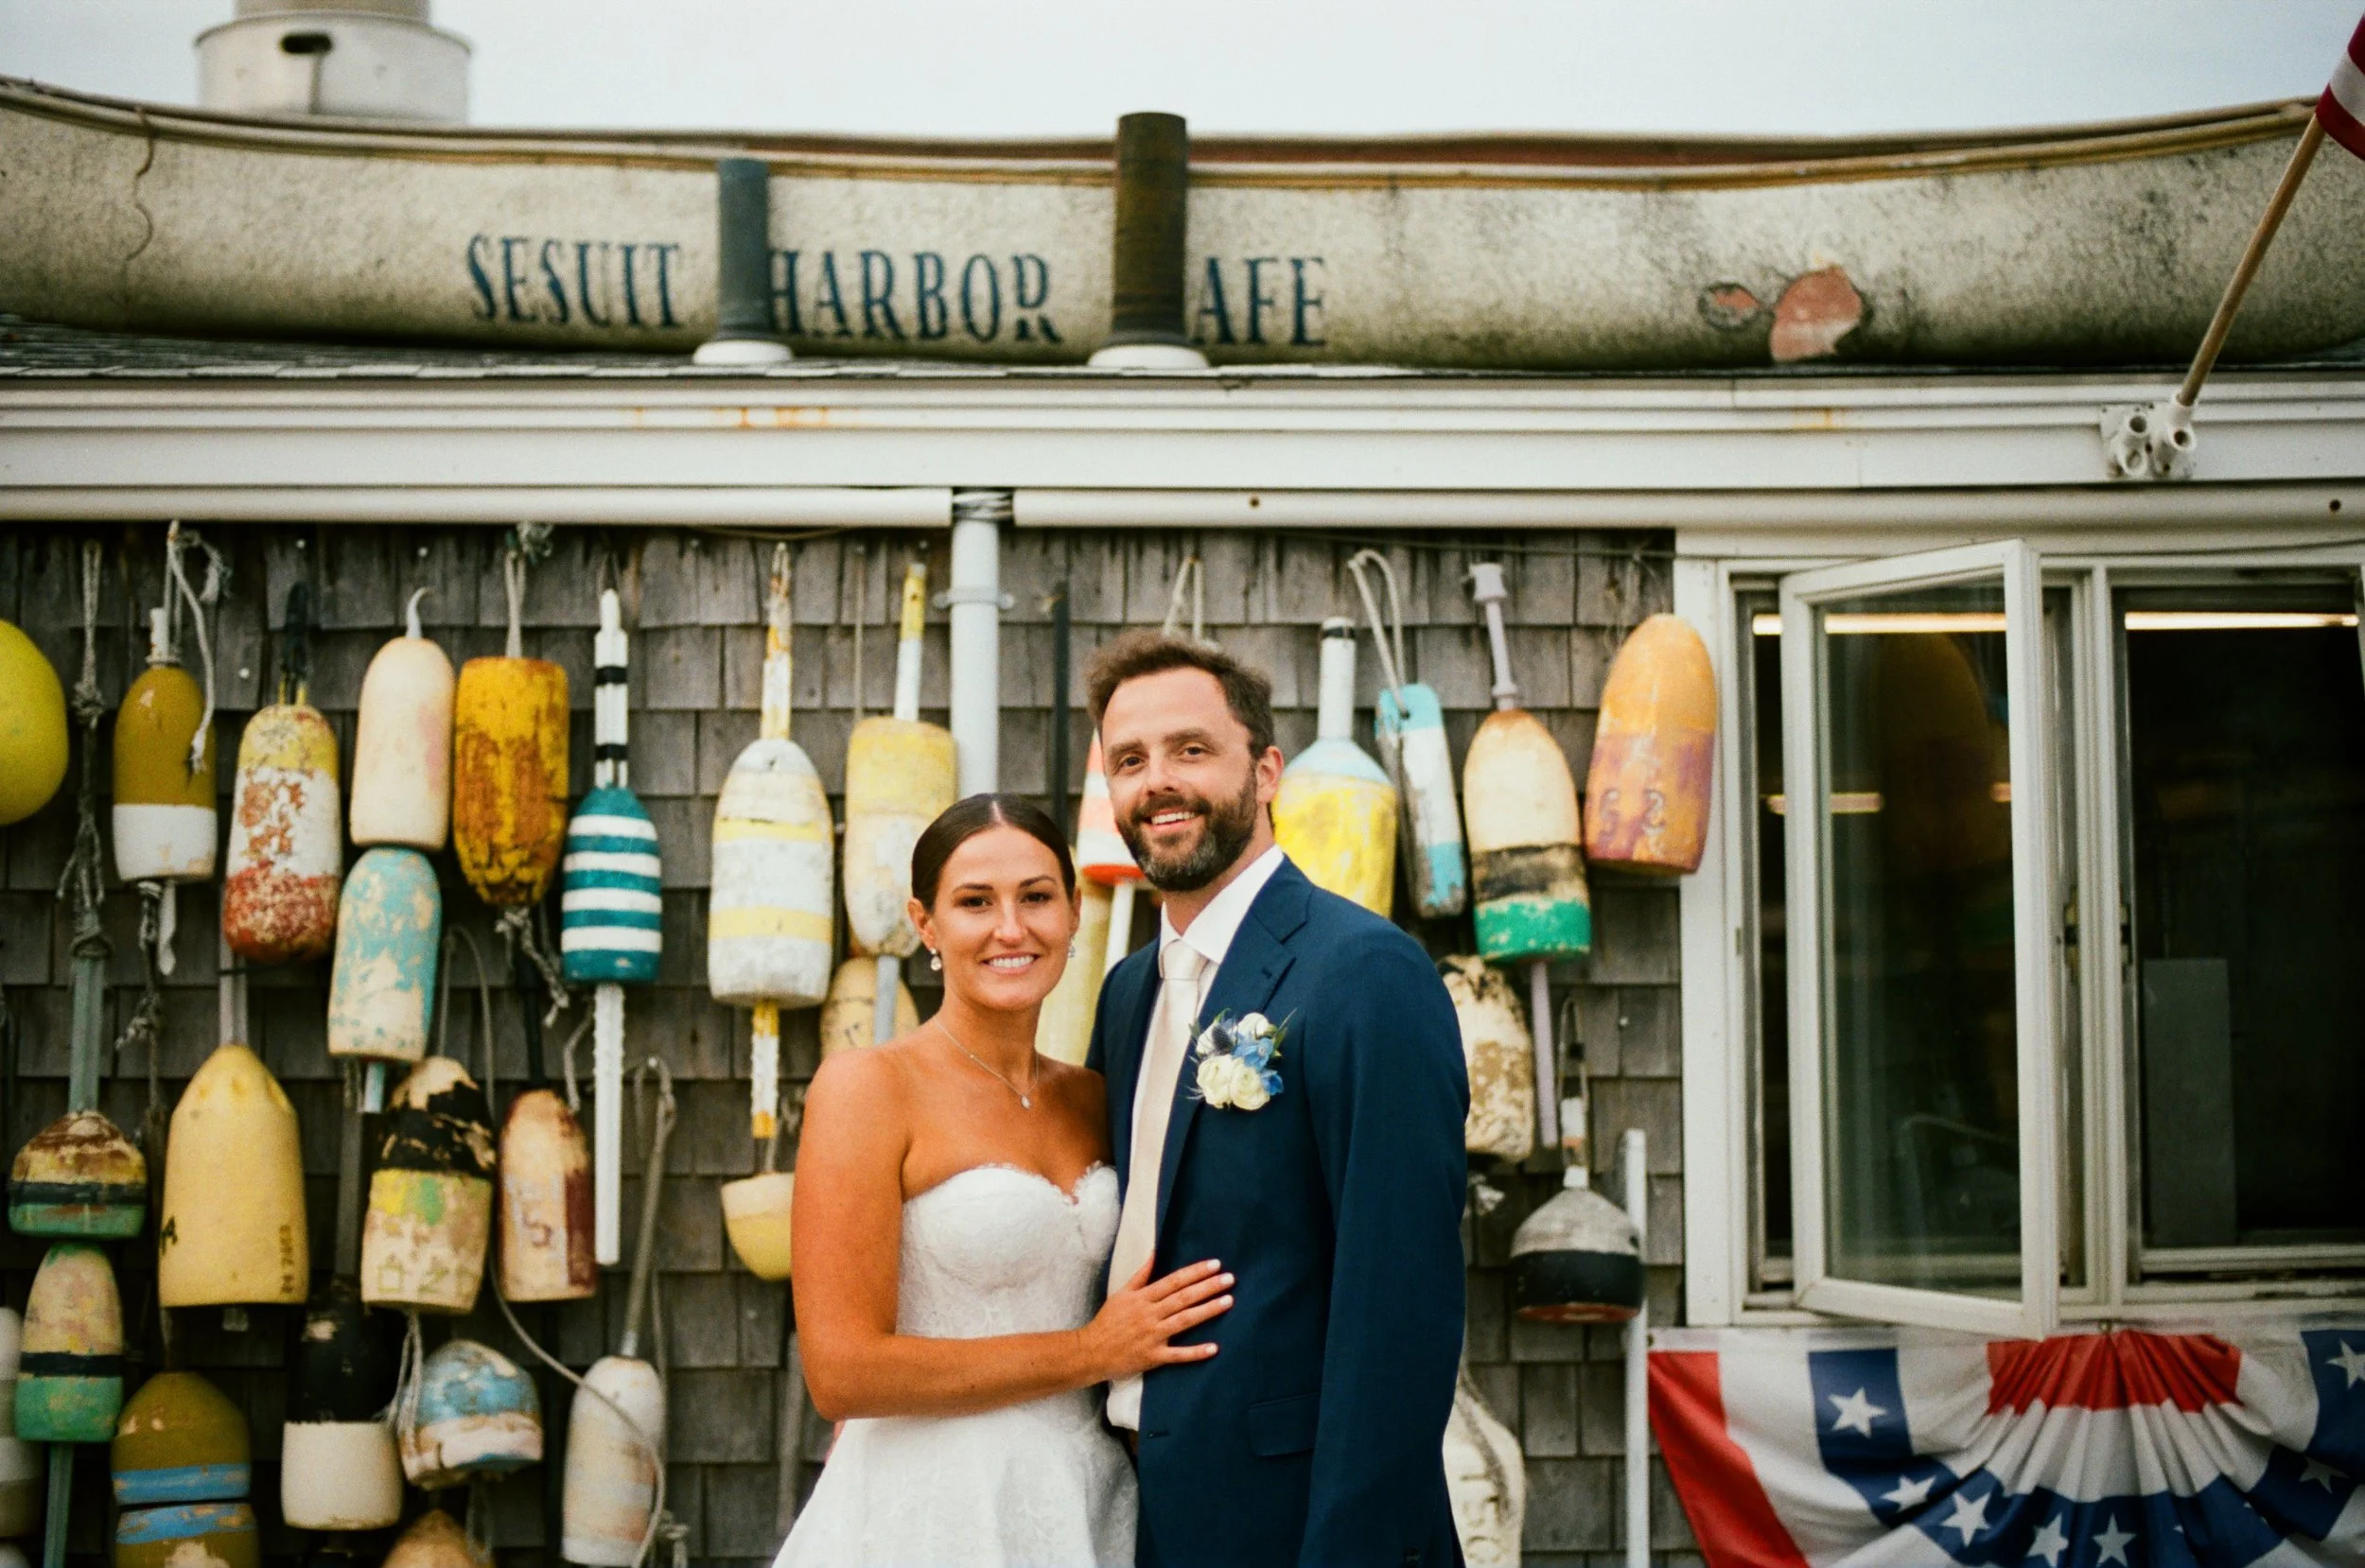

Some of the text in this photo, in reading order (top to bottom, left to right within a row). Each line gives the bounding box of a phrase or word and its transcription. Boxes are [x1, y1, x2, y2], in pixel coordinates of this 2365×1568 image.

[466, 234, 1328, 347] SESUIT HARBOR AFE
